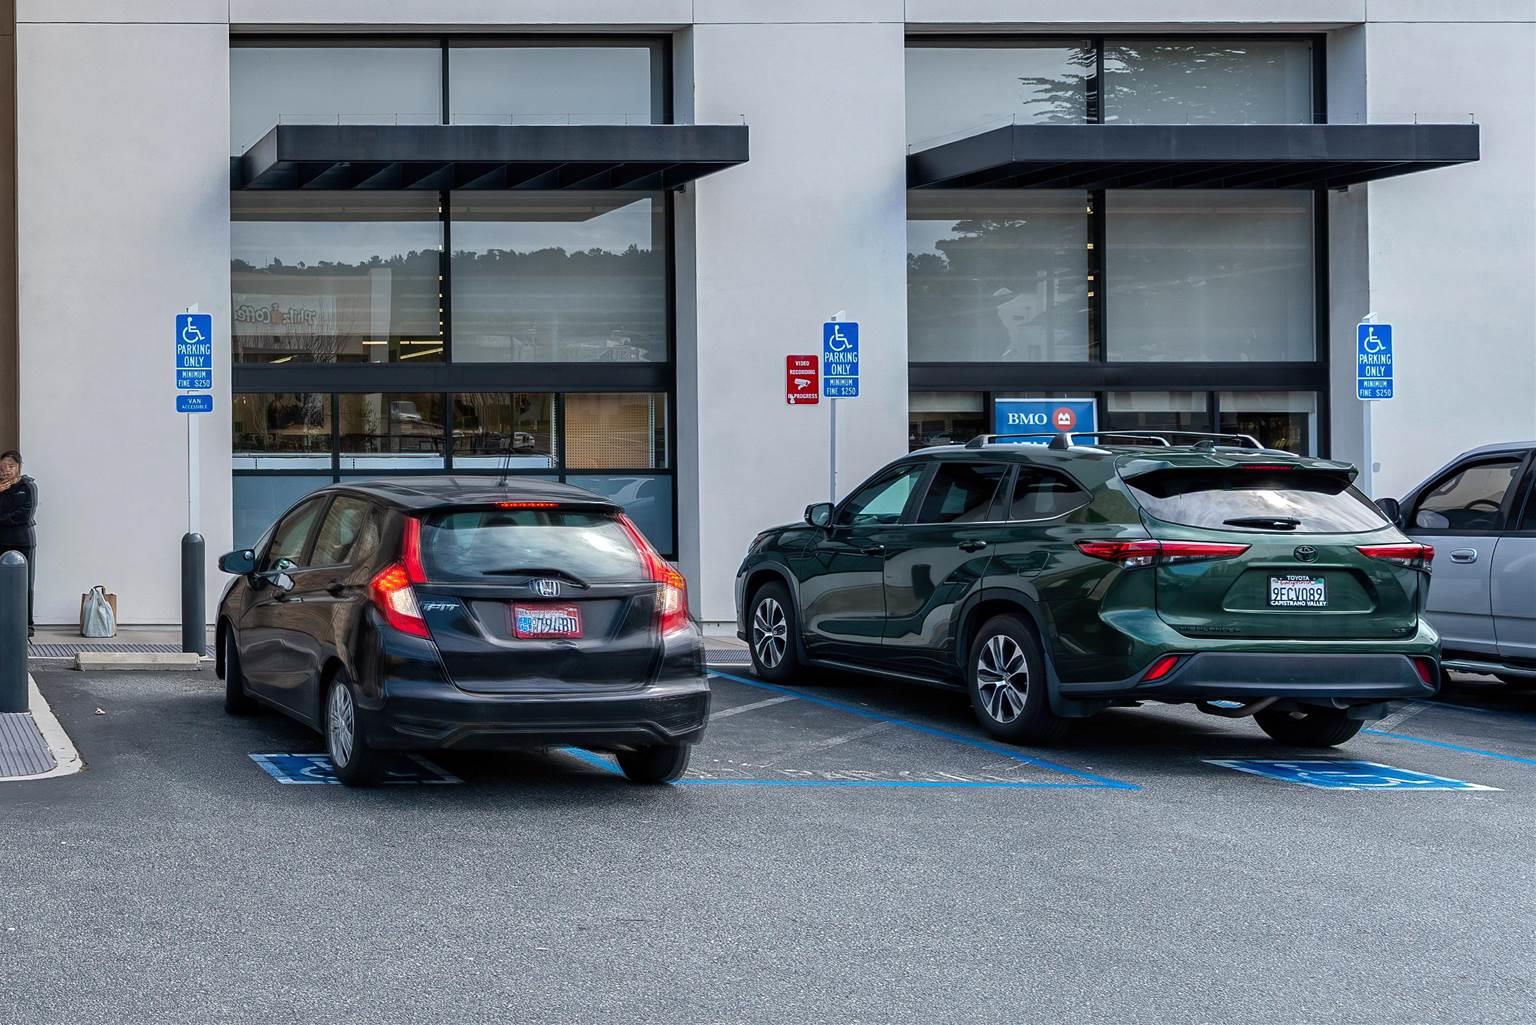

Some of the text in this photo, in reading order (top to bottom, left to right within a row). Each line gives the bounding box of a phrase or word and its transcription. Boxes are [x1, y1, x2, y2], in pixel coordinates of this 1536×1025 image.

[177, 343, 211, 355] PARKING
[184, 356, 205, 367] ONLY
[824, 351, 858, 363] PARKING
[1359, 353, 1392, 365] PARKING
[182, 370, 206, 379] MINIMUM
[831, 363, 851, 375] ONLY
[1365, 365, 1386, 377] ONLY
[178, 379, 211, 387] FINE $250
[829, 378, 853, 386] MINIMUM
[1363, 380, 1388, 388] MINIMUM
[826, 387, 856, 395] FINE $250
[1359, 389, 1392, 397] FINE $250
[1007, 412, 1048, 425] BMO
